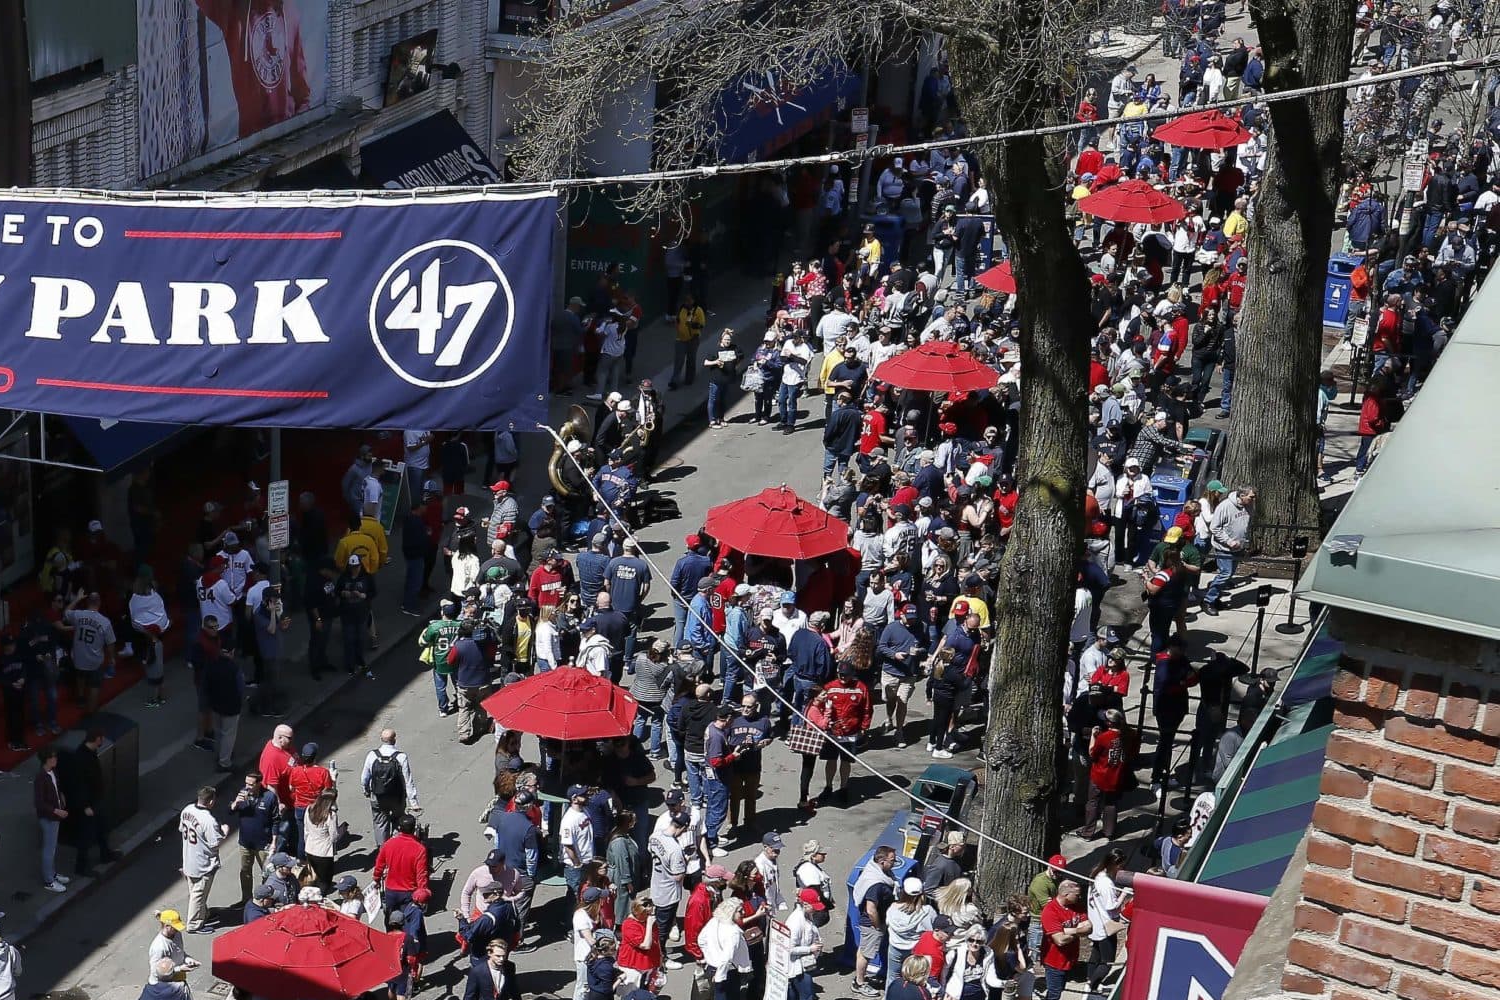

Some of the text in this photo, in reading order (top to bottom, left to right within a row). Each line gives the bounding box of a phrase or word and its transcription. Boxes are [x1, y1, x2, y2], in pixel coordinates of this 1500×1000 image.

[45, 214, 106, 247] TO
[571, 259, 625, 273] ENTRANE
[24, 275, 330, 347] PARK
[198, 588, 215, 601] 34
[79, 628, 97, 645] 15
[182, 823, 198, 845] 33
